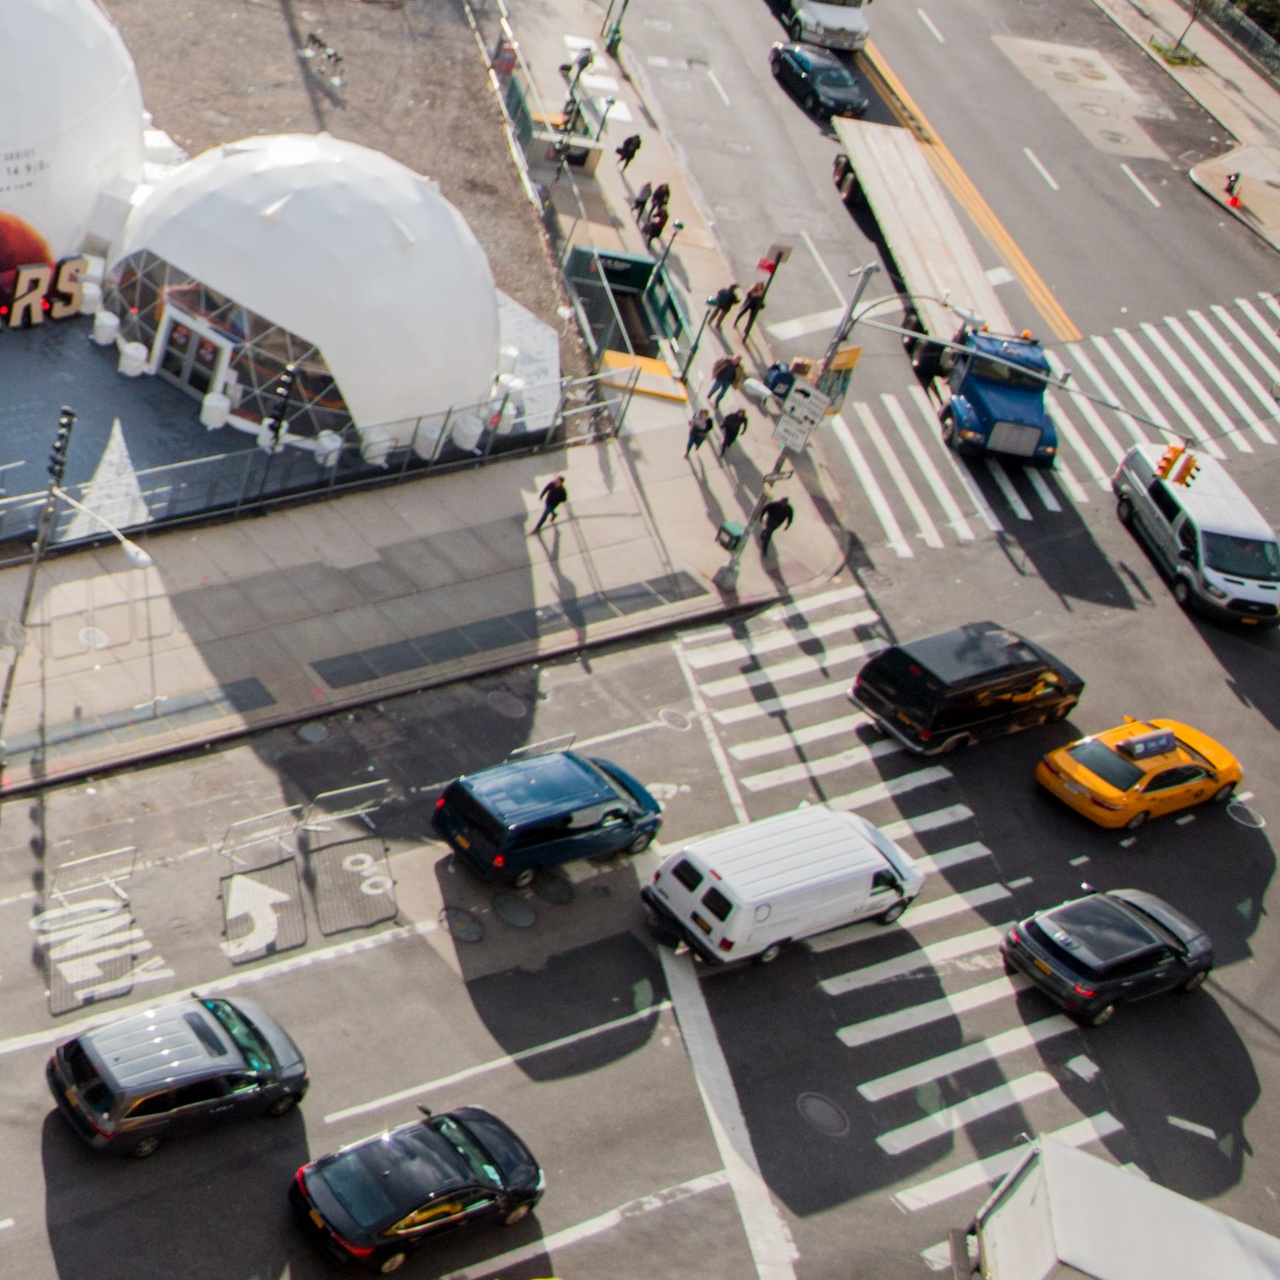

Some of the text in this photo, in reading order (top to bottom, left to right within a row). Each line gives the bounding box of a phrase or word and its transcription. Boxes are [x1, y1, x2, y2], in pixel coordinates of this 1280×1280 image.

[3, 148, 36, 162] SERIES
[6, 166, 20, 176] 14
[28, 899, 176, 1003] ONLY
